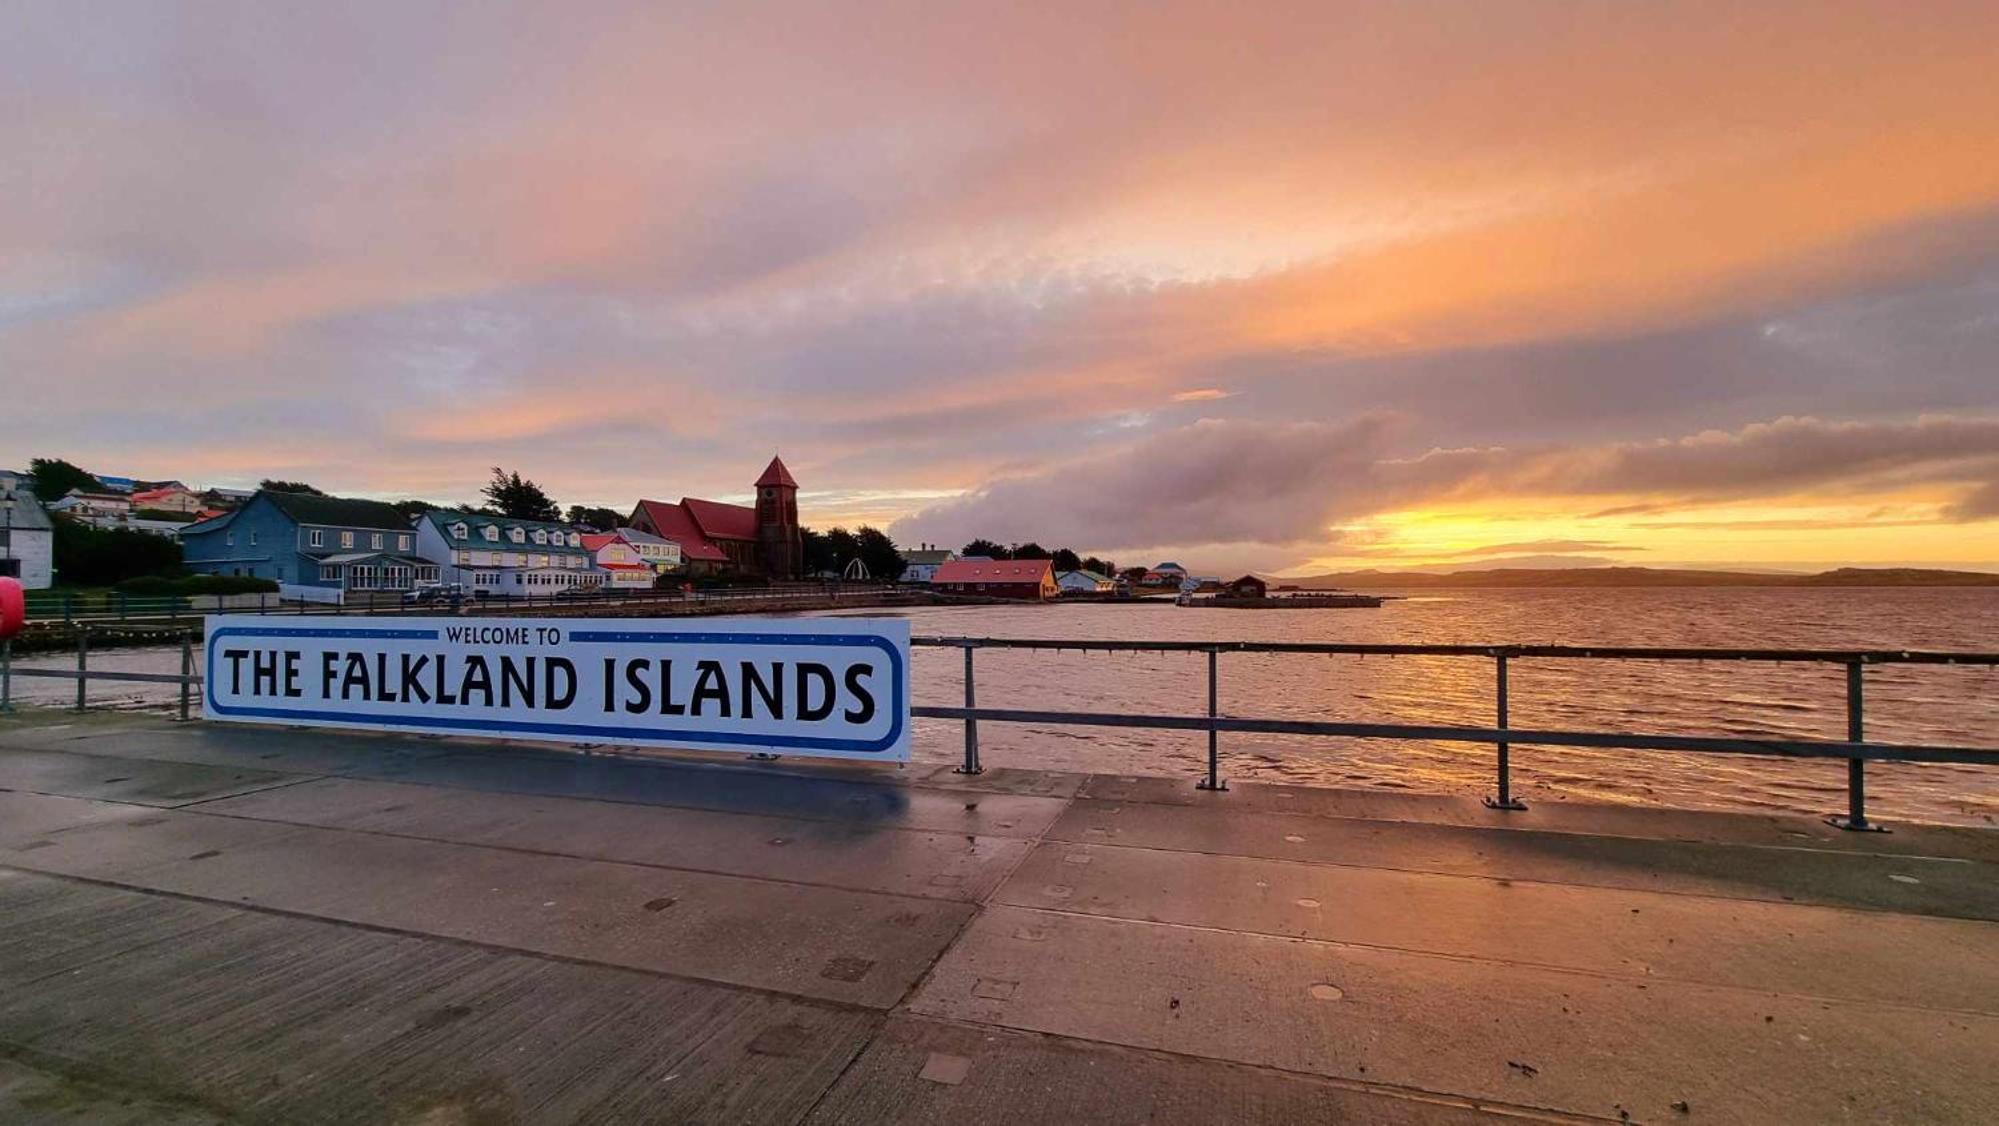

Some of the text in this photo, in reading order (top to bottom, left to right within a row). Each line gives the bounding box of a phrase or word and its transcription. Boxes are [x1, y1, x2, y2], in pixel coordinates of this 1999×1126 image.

[446, 626, 561, 646] WELCOME TO
[223, 649, 876, 724] THE FALKLAND ISLANDS
